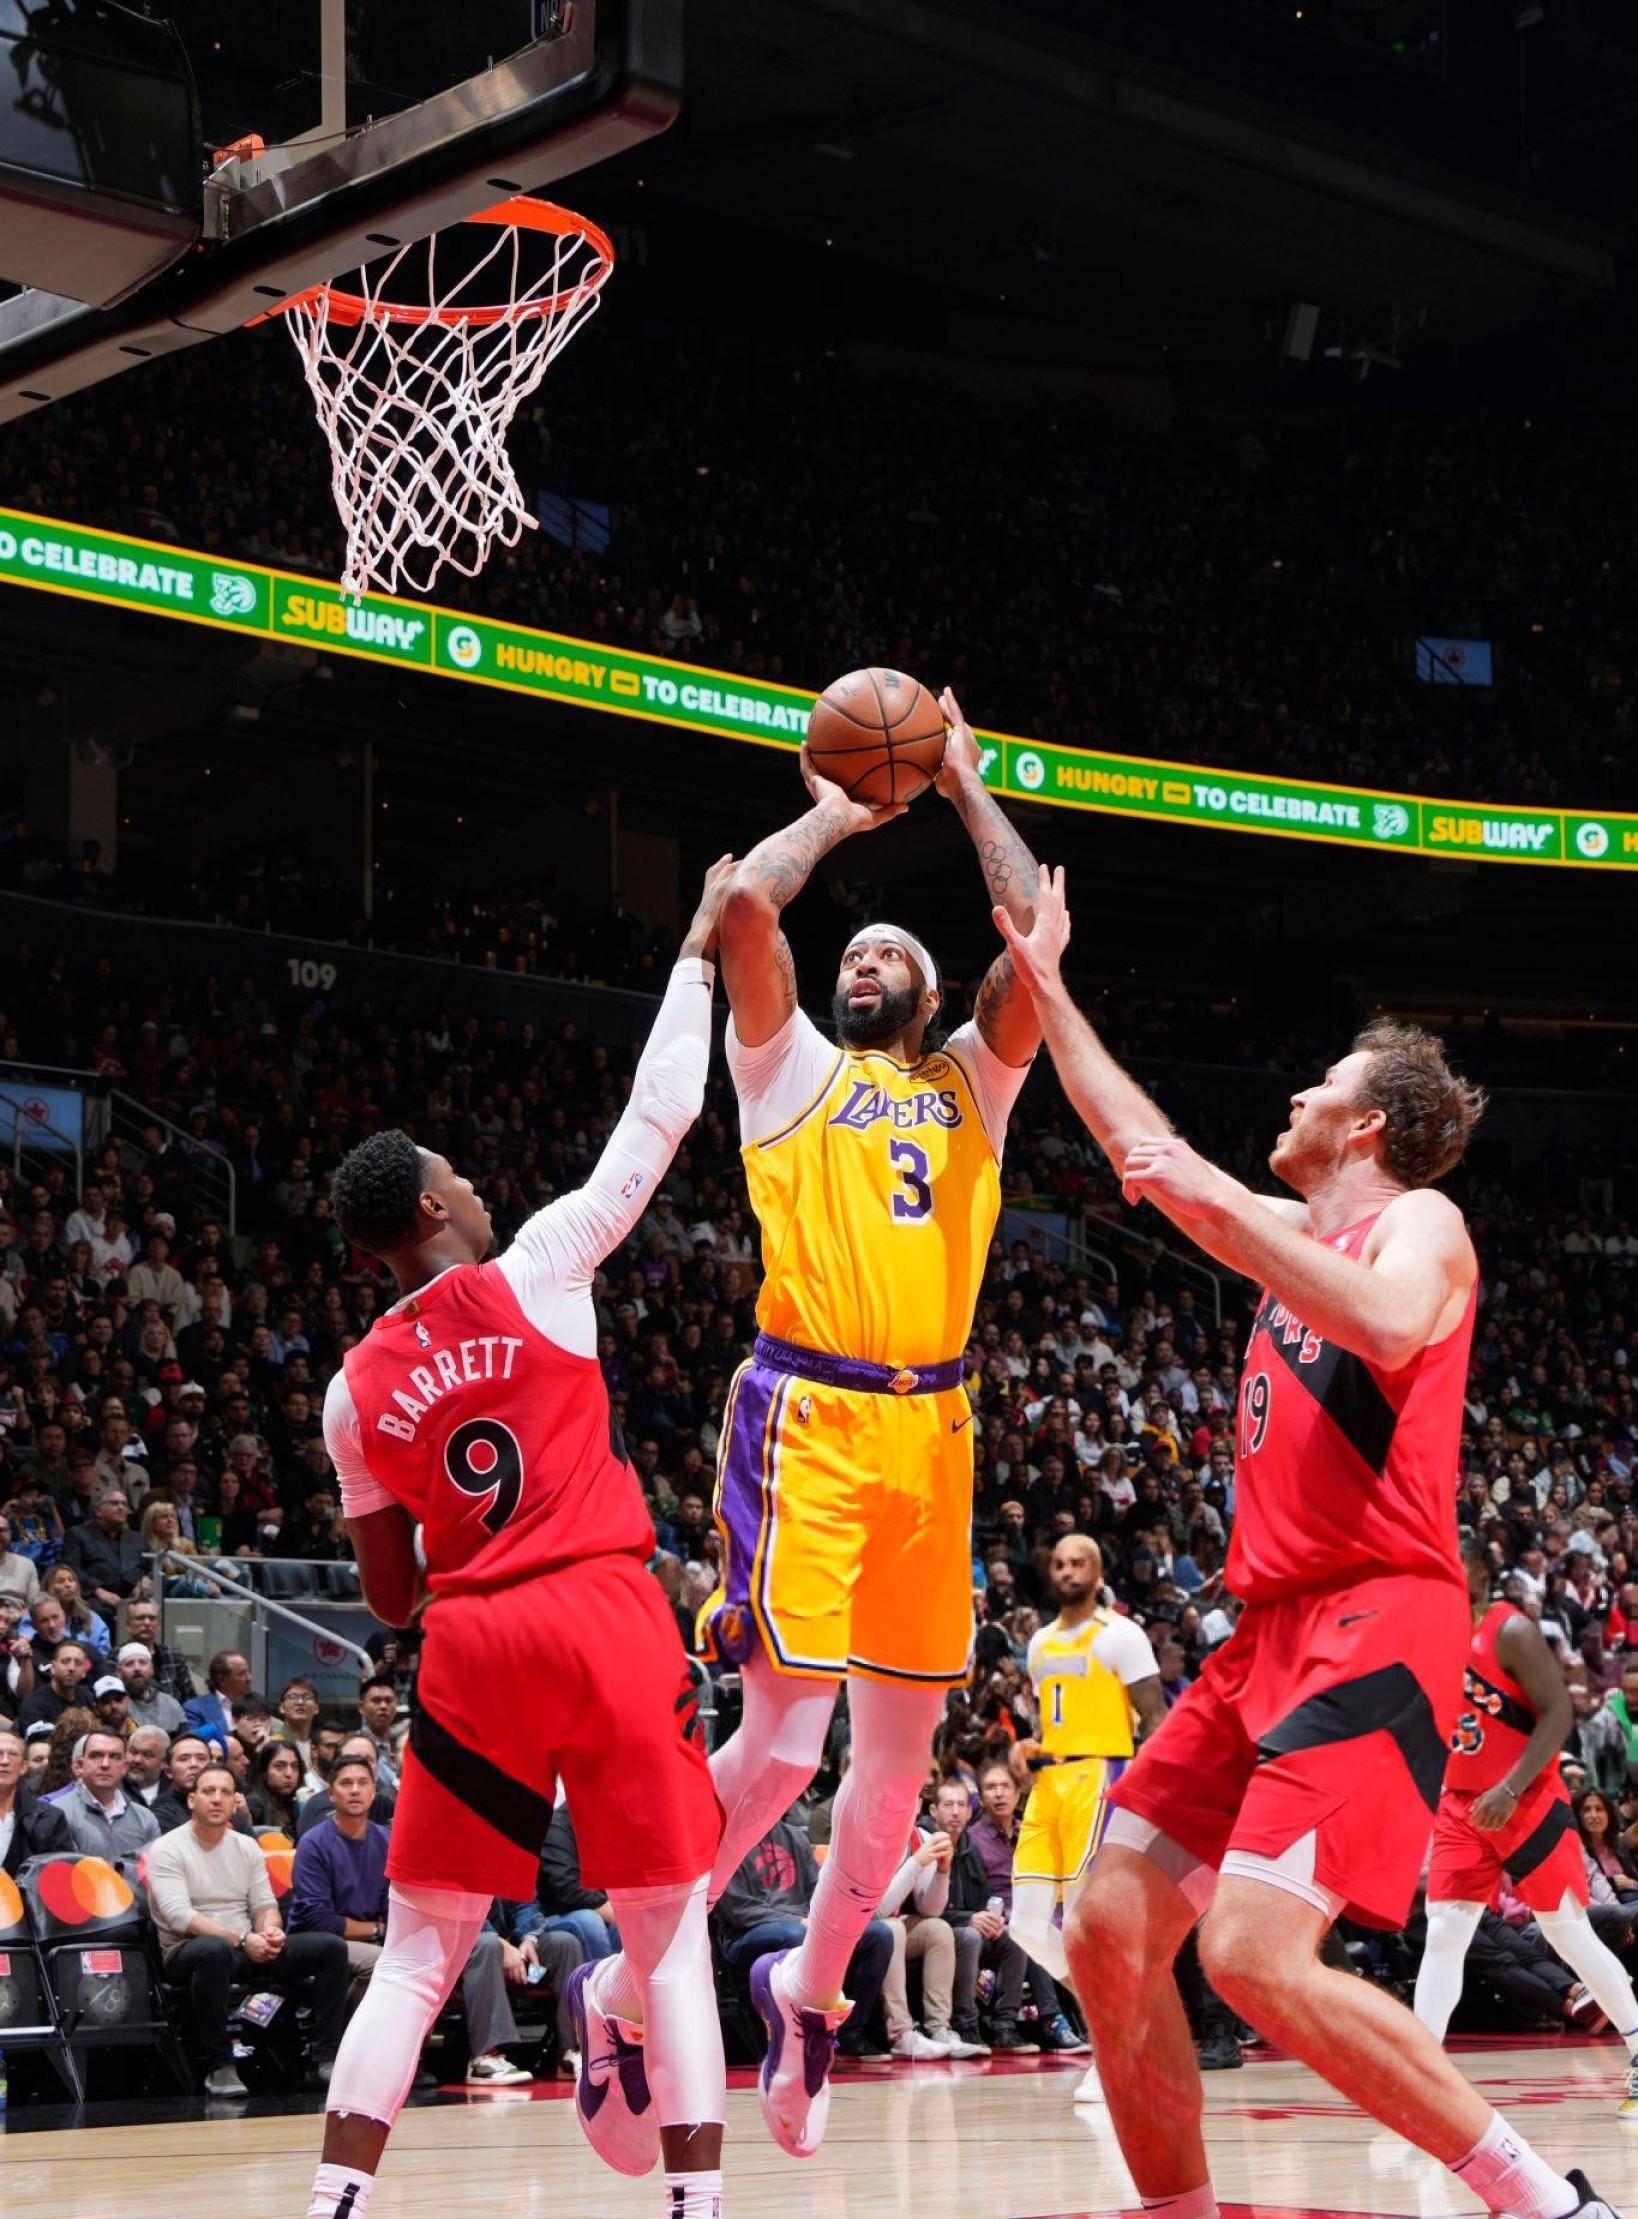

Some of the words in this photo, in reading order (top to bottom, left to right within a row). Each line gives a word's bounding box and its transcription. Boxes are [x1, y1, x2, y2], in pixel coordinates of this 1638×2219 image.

[21, 537, 193, 599] CELEBRATE
[282, 595, 425, 650] SUBWAY
[497, 643, 607, 688] HUNGRY
[643, 676, 678, 705] TO
[1056, 766, 1157, 801] HUNGRY
[1194, 785, 1227, 811] TO
[1230, 791, 1360, 828] CELEBRATE
[1430, 816, 1554, 850] SUBWAY
[287, 958, 336, 991] 109
[888, 1137, 933, 1225] 3
[377, 1336, 523, 1443] BARRETT
[1240, 1371, 1272, 1459] 19
[444, 1417, 525, 1536] 9
[1052, 1682, 1063, 1727] 1
